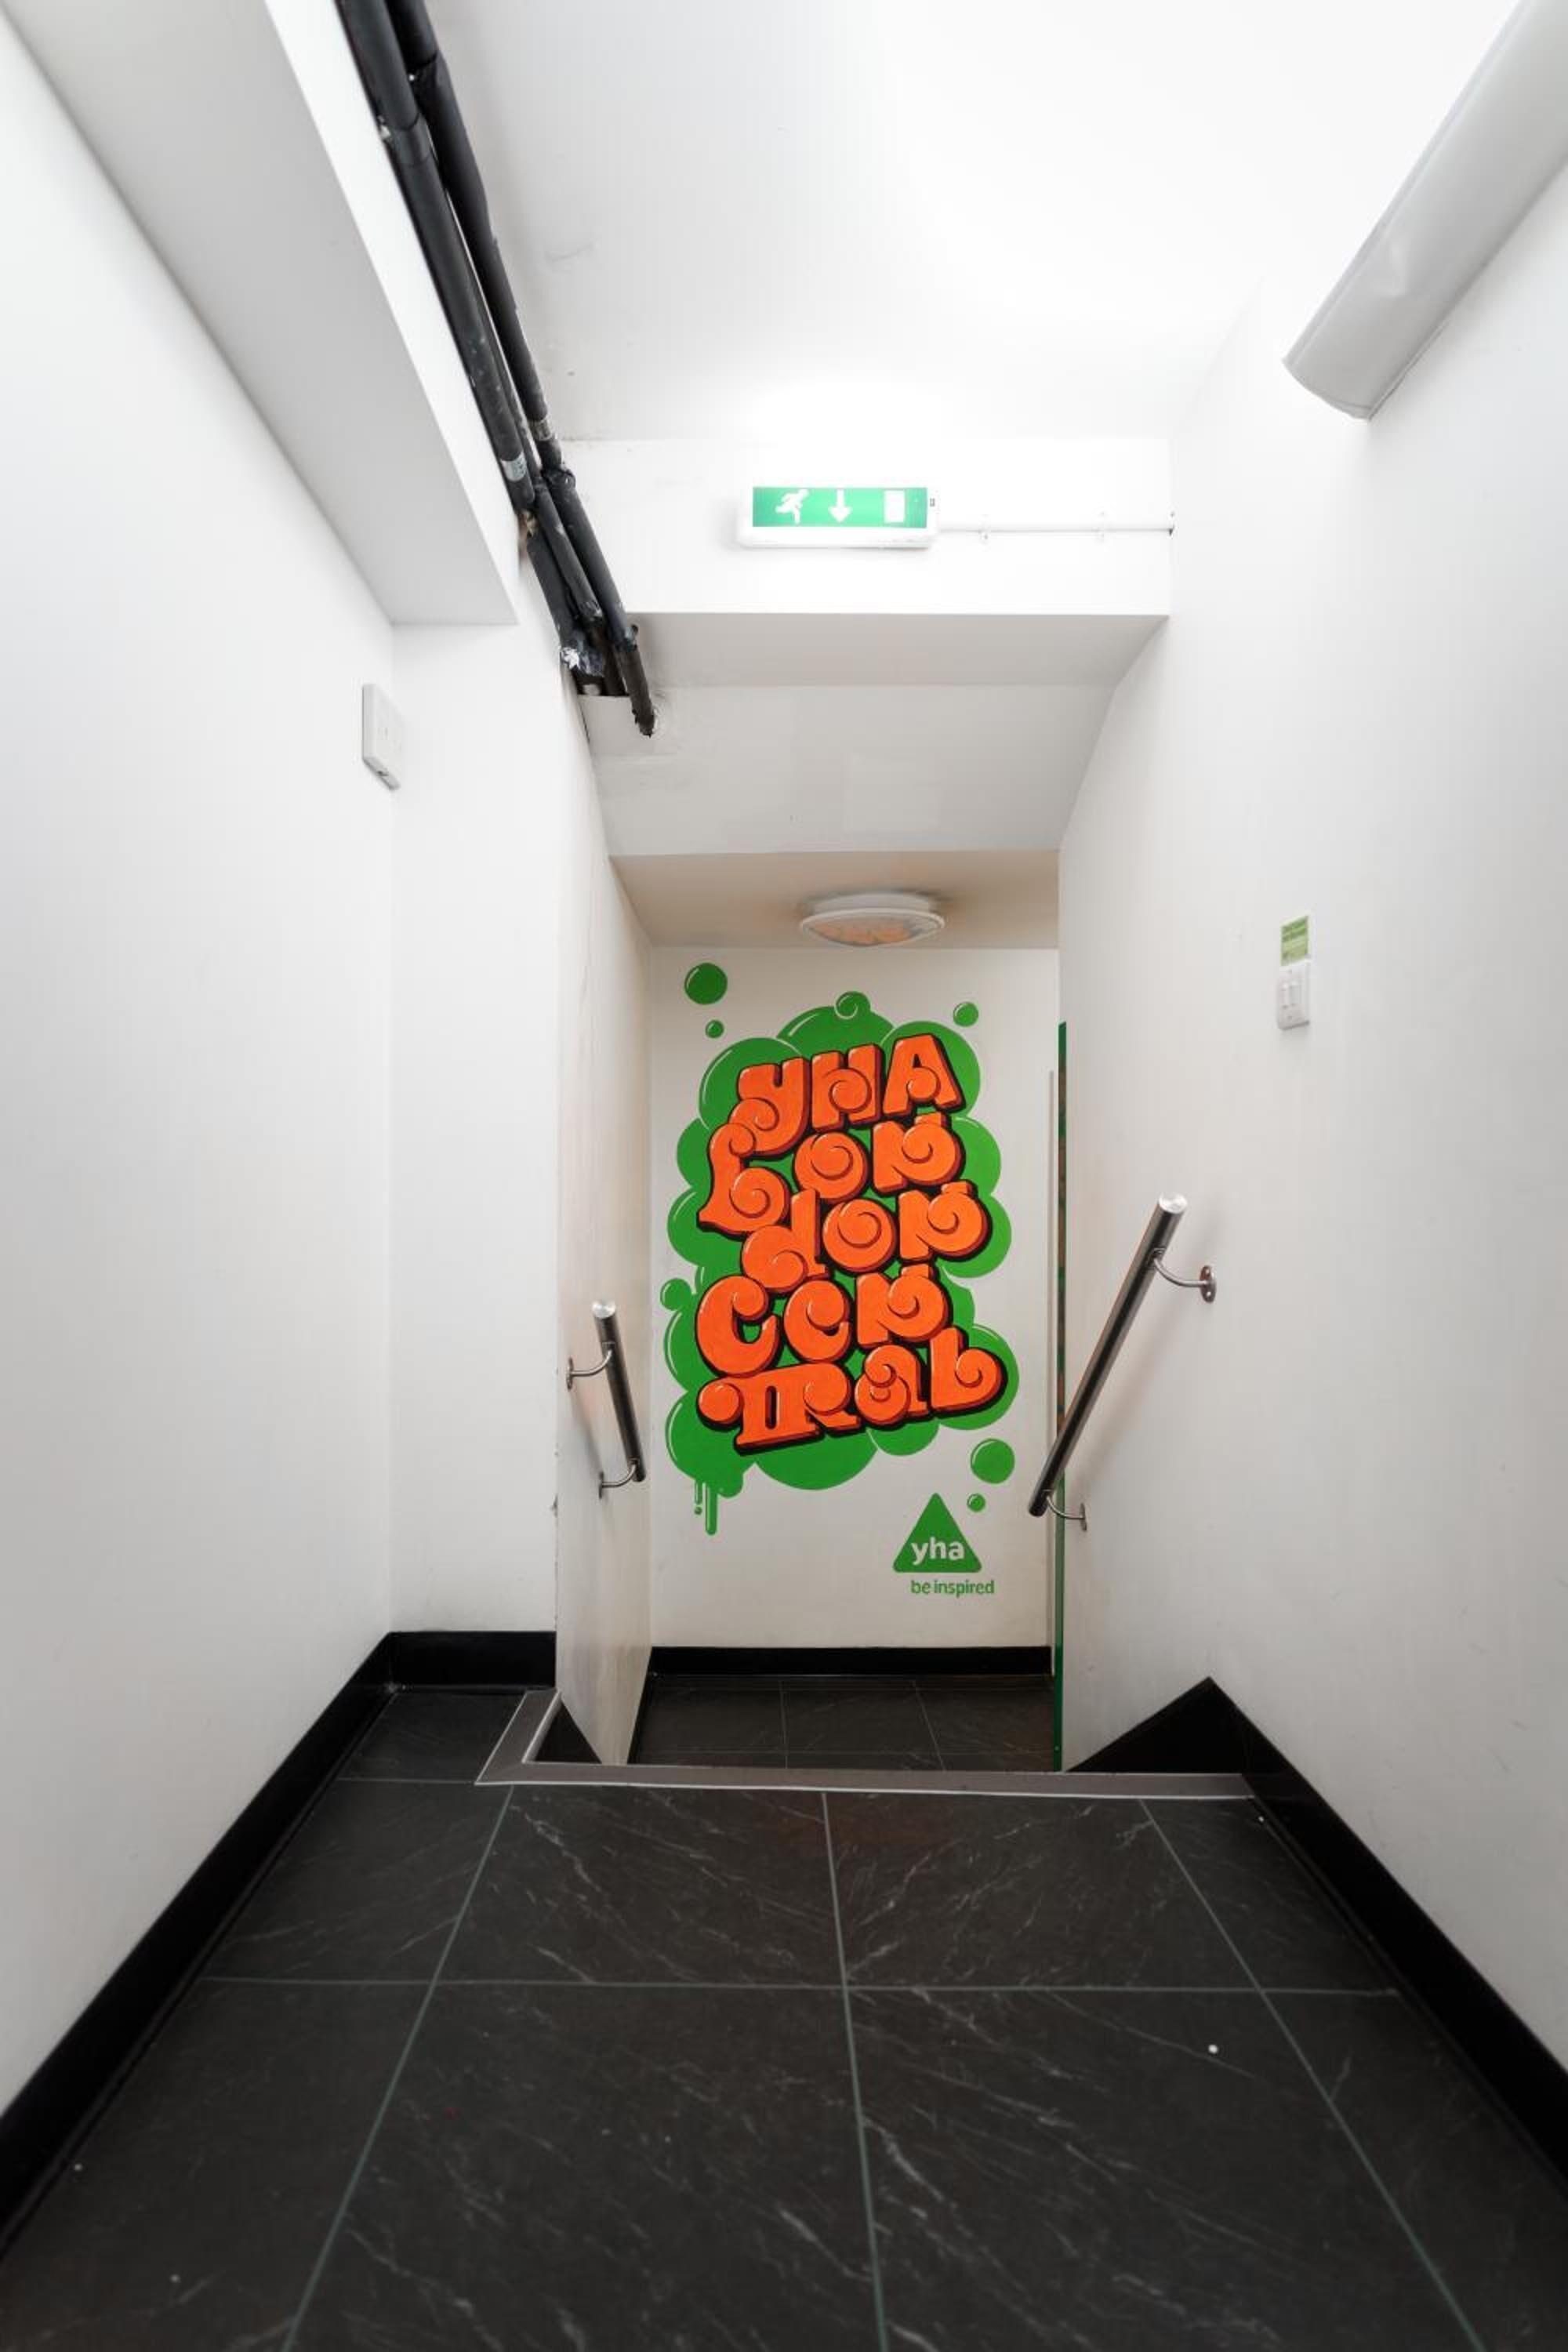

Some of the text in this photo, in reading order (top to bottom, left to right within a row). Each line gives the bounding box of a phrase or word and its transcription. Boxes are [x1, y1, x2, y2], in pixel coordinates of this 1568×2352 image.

[910, 1537, 965, 1566] yha
[910, 1579, 995, 1599] be inspired
